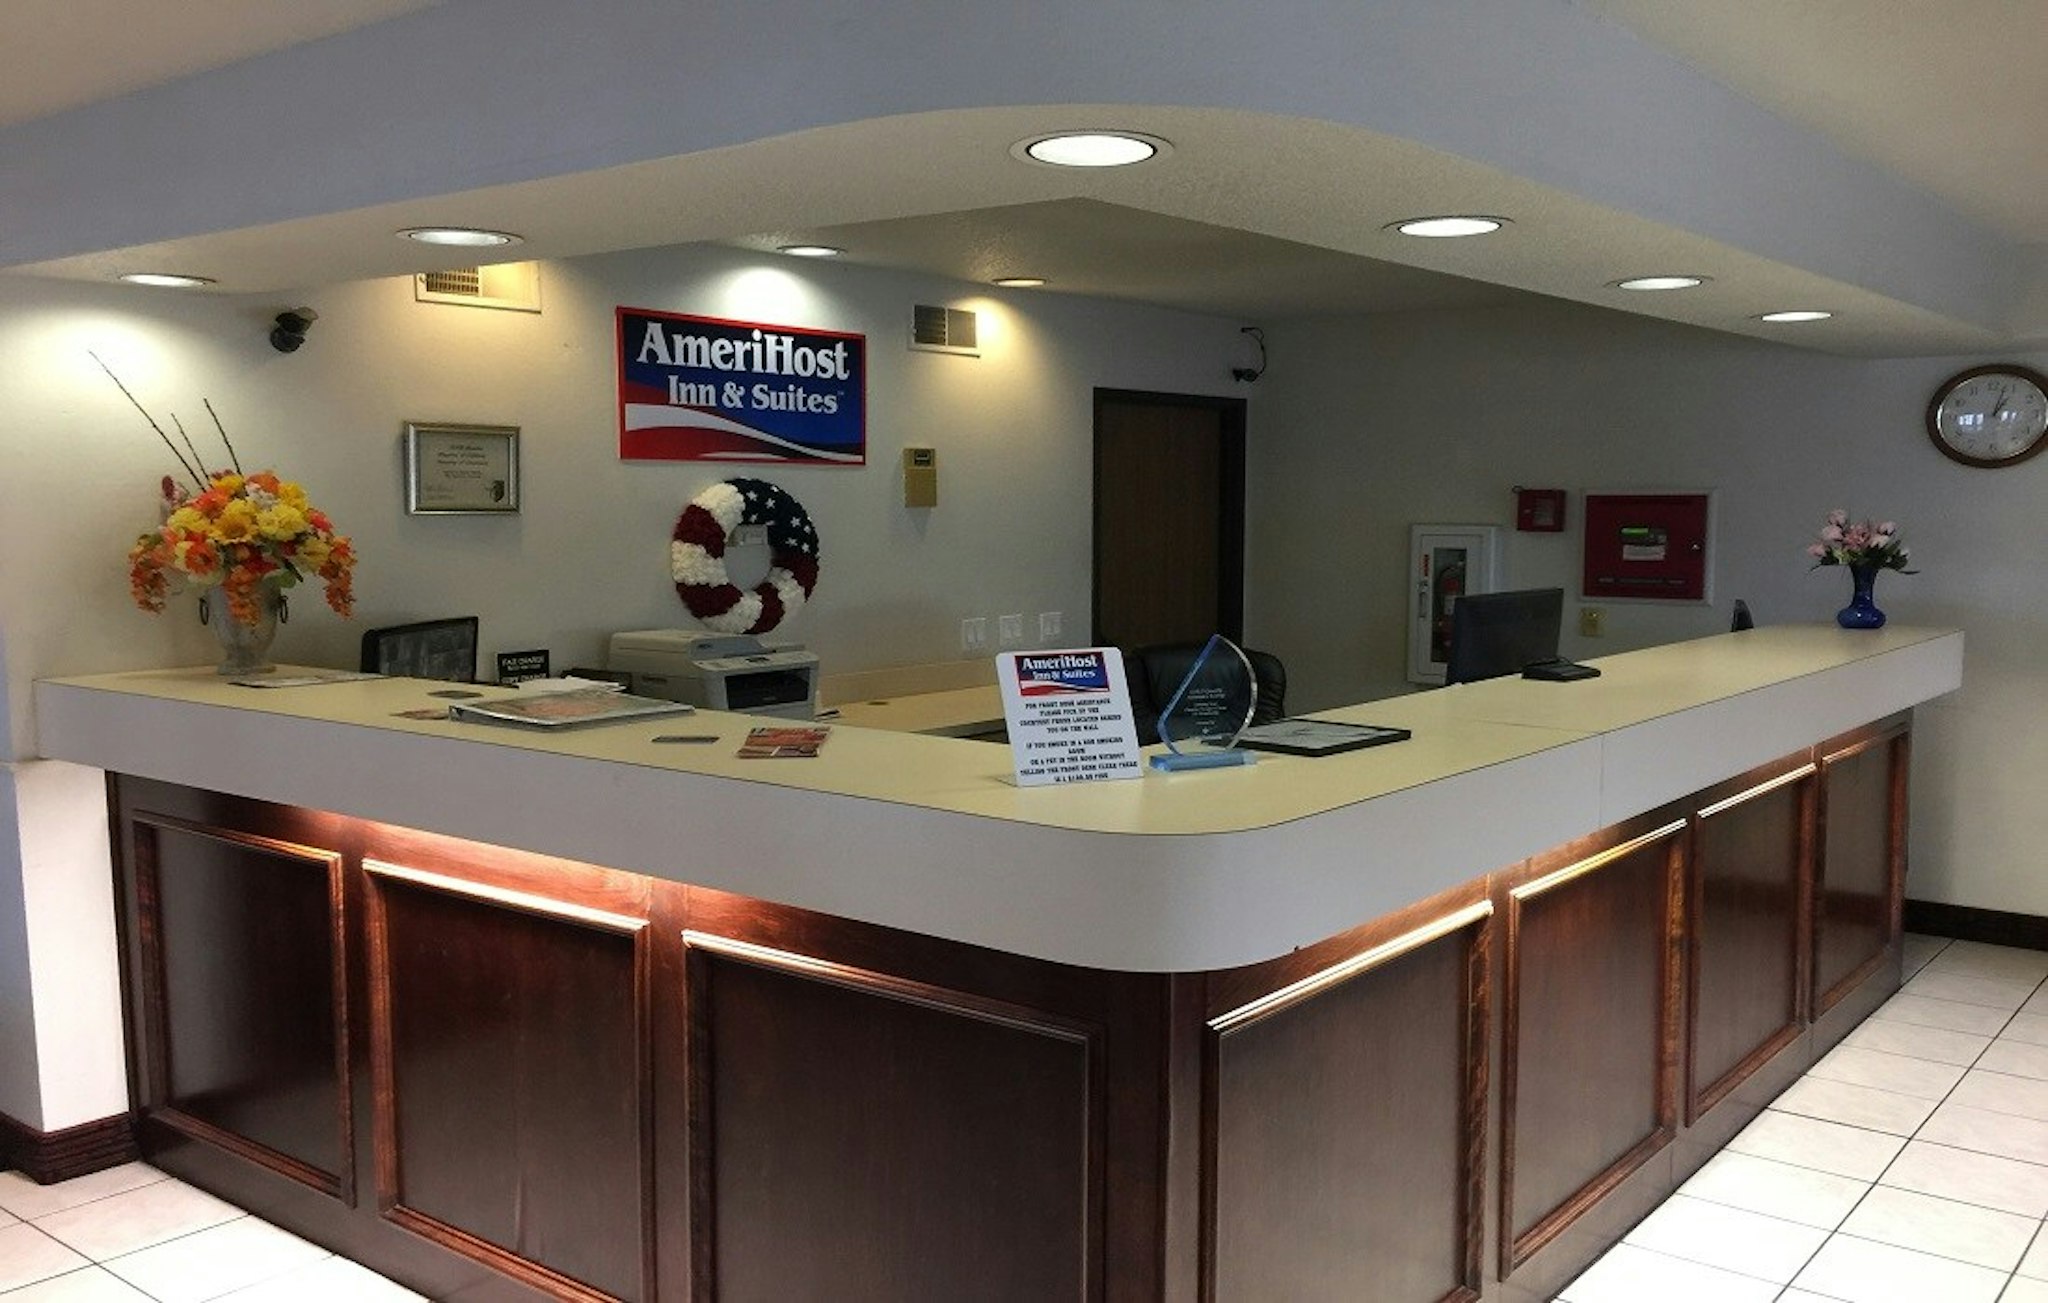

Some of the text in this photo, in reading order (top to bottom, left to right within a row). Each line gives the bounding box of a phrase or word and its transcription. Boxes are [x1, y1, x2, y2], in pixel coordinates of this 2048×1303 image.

[636, 321, 850, 380] AmeriHost
[667, 374, 838, 414] Inn & Suites
[1022, 655, 1098, 670] AmeriHost
[1033, 669, 1096, 680] Inn & Suites
